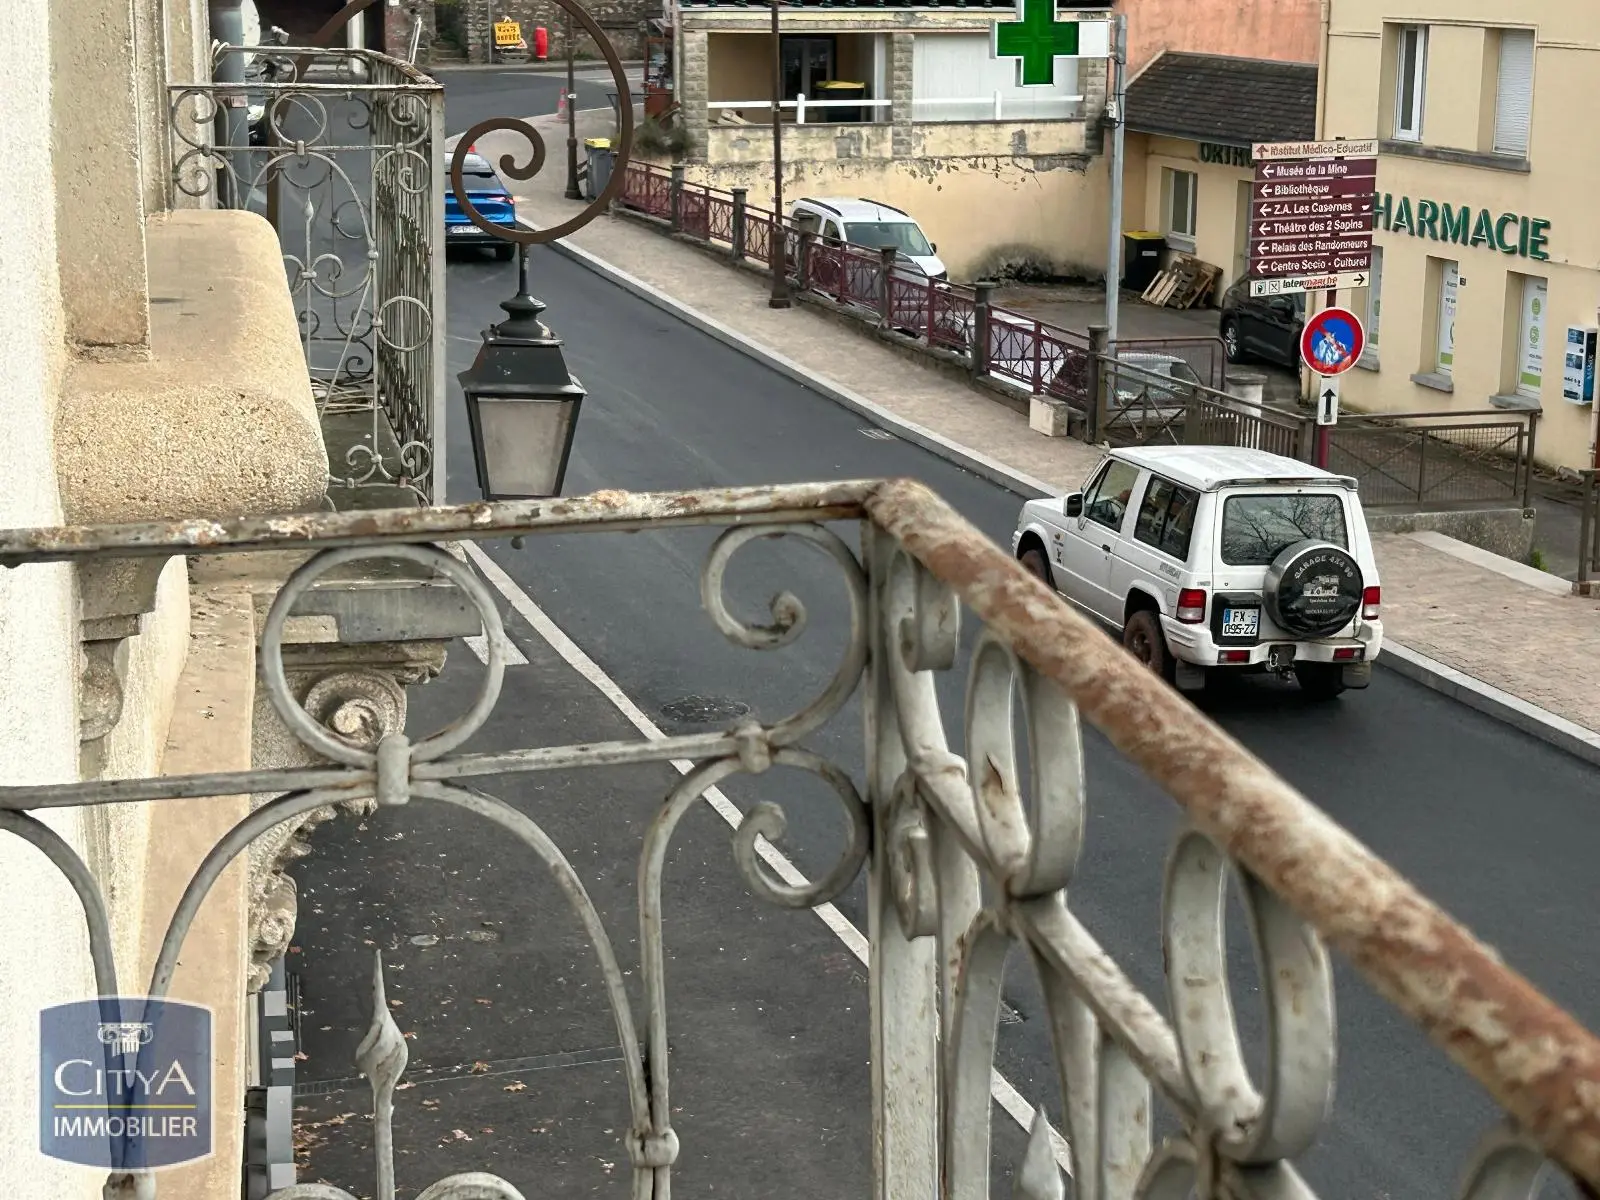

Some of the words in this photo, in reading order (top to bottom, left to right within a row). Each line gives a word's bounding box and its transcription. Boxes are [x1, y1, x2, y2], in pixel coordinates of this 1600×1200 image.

[1270, 145, 1301, 156] Institut
[1276, 166, 1304, 177] Musée
[1305, 165, 1316, 175] de
[1318, 165, 1326, 175] la
[1327, 163, 1348, 174] Mine
[1274, 184, 1330, 196] Bibliothèque
[1273, 204, 1292, 215] Z.A.
[1293, 203, 1309, 214] Les
[1311, 202, 1353, 213] Casernes
[1273, 223, 1306, 234] Théâtre
[1308, 221, 1325, 232] des
[1326, 220, 1333, 231] 2
[1334, 219, 1363, 232] Sapins
[1372, 191, 1552, 261] HARMACIE
[1271, 242, 1296, 253] Relais
[1298, 241, 1313, 252] des
[1315, 240, 1368, 251] Randonneurs
[1270, 261, 1300, 272] Centre
[1301, 259, 1326, 270] Socio
[1333, 257, 1368, 268] Culturel
[1294, 554, 1327, 579] GARAGE
